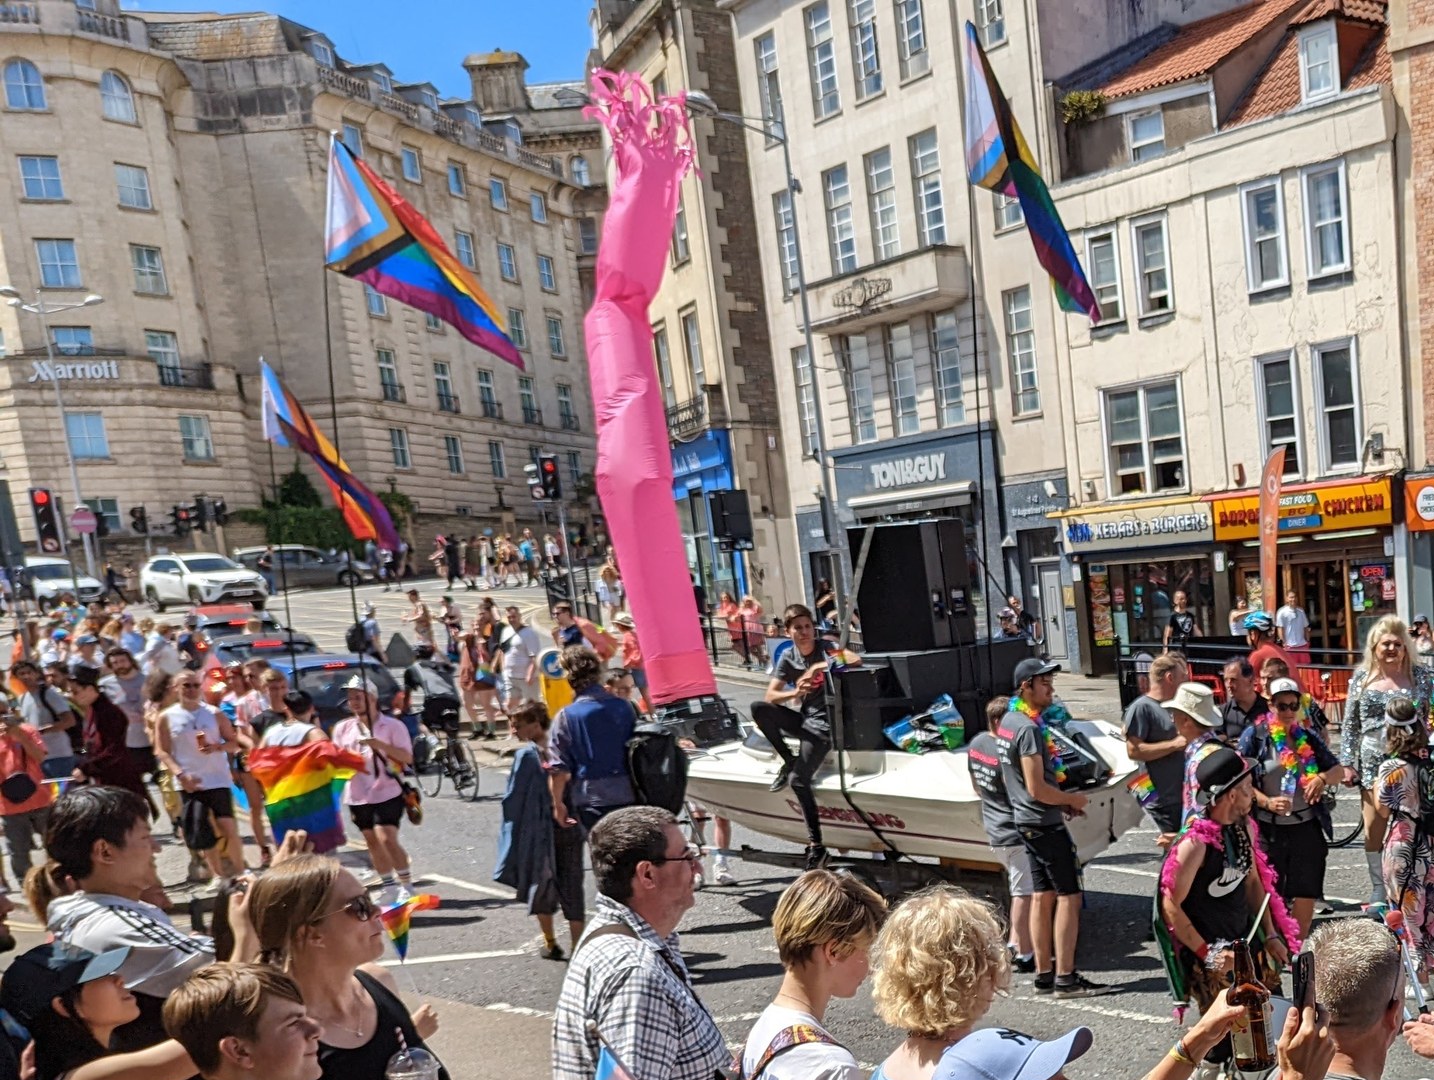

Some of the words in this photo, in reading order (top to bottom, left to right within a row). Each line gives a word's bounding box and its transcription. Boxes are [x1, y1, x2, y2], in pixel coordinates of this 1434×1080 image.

[28, 360, 119, 382] Marriott
[871, 453, 946, 488] TONI&GUY
[1279, 497, 1292, 506] FAST
[1293, 495, 1313, 504] FOOD
[1324, 493, 1384, 517] CHICKEN
[1287, 507, 1306, 517] BC
[1096, 519, 1142, 540] KEBABS
[1151, 513, 1208, 534] BURGERS
[1287, 518, 1307, 528] DINER
[1361, 566, 1384, 577] OPEN
